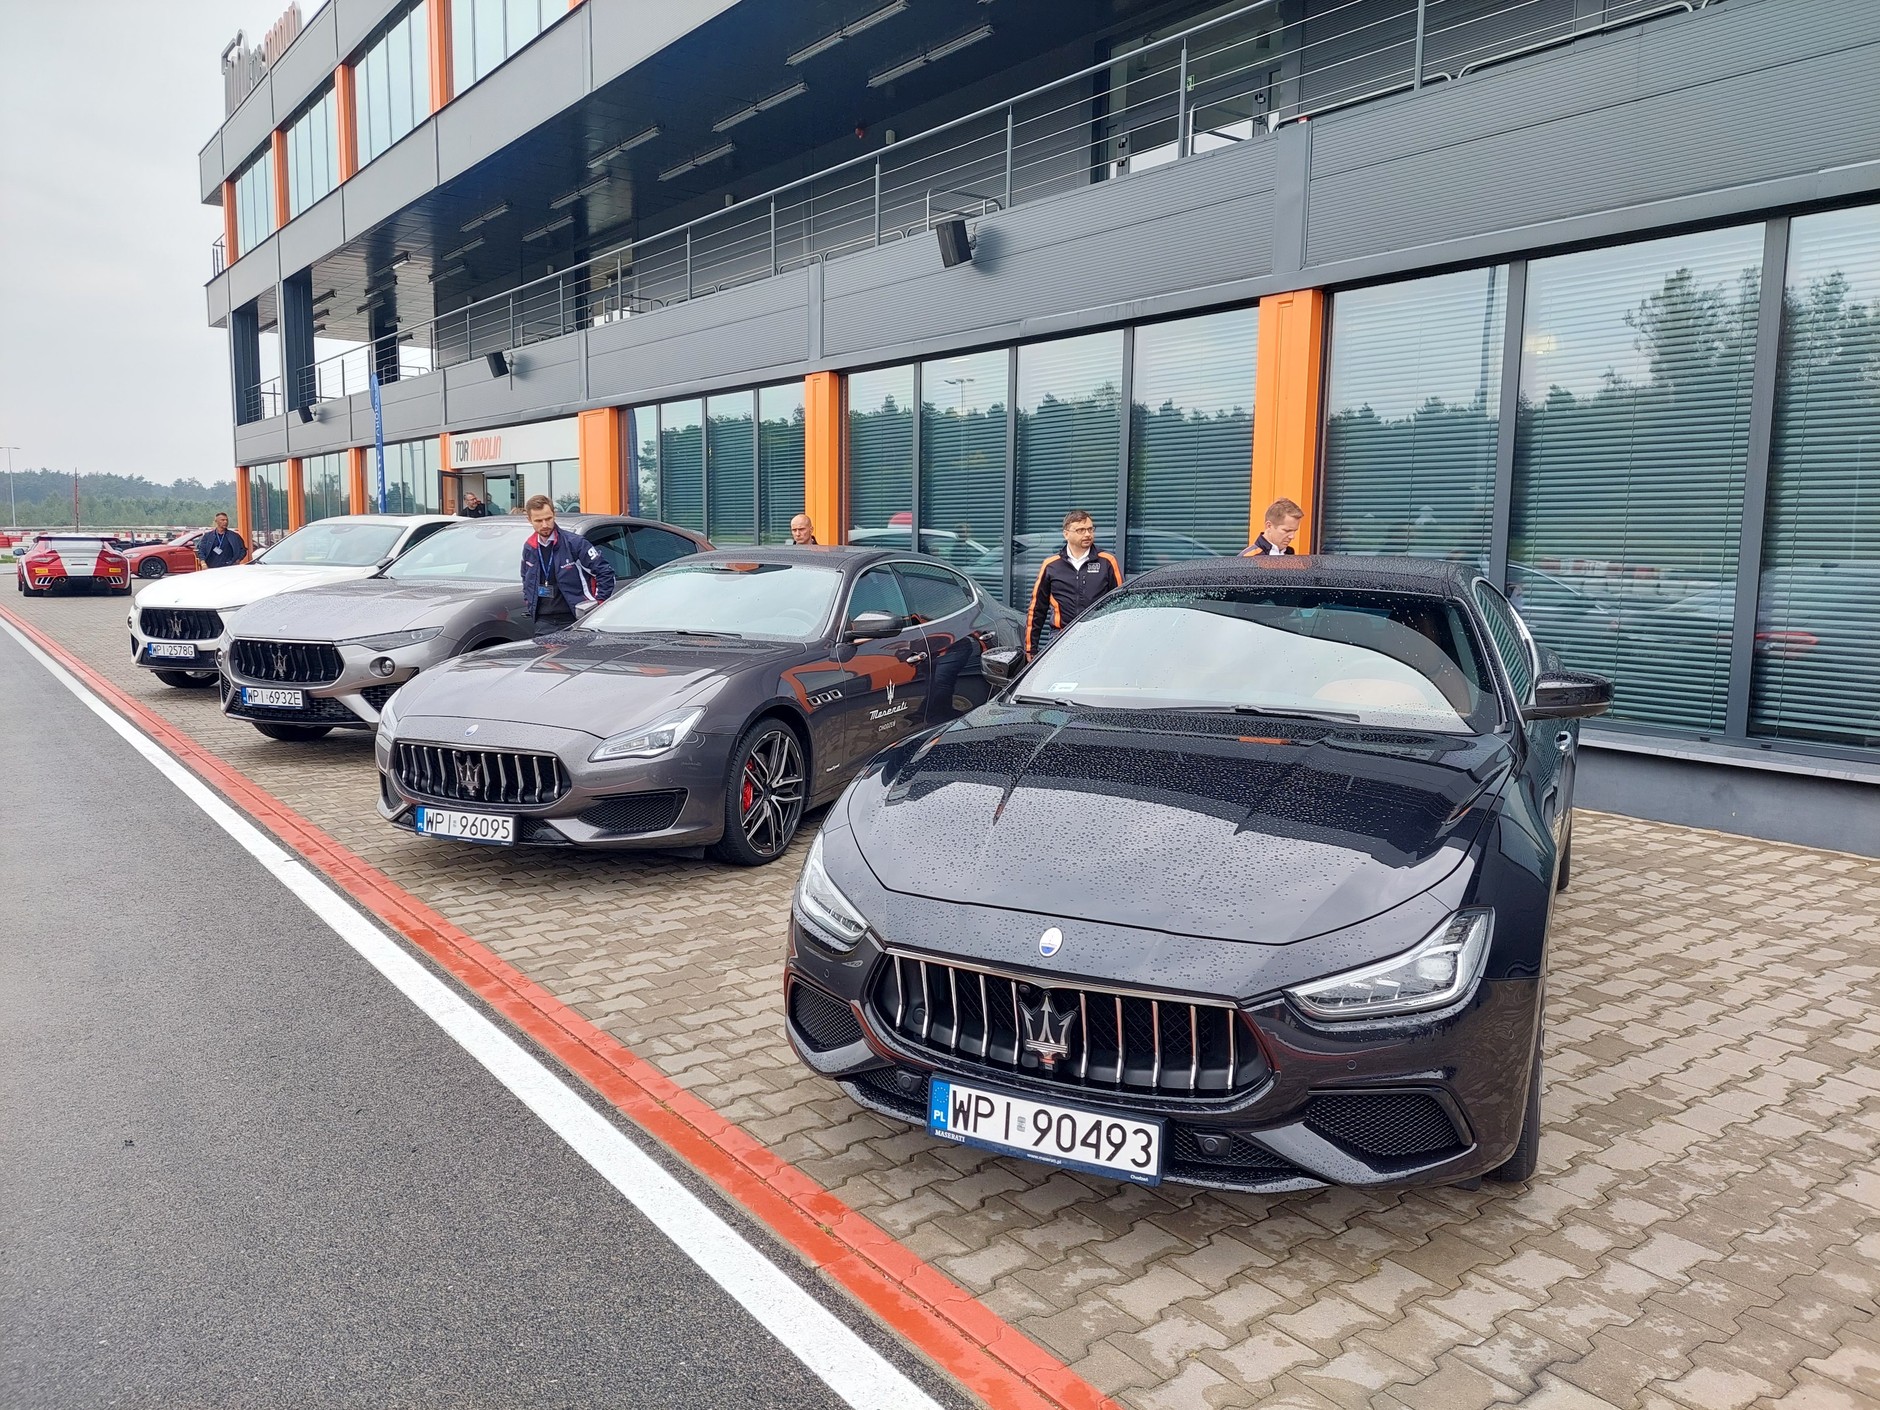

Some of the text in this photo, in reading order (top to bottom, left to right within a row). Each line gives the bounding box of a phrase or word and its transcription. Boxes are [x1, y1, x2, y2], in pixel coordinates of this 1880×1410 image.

[455, 435, 502, 463] TOR MODLIN
[151, 644, 194, 656] WPI 2578G
[247, 689, 302, 706] WPI 6932E
[869, 700, 909, 721] Maserati
[425, 810, 511, 840] WPI 96095
[933, 1109, 947, 1123] PL
[934, 1129, 966, 1143] MASERATI
[952, 1089, 1153, 1169] WPI 90493
